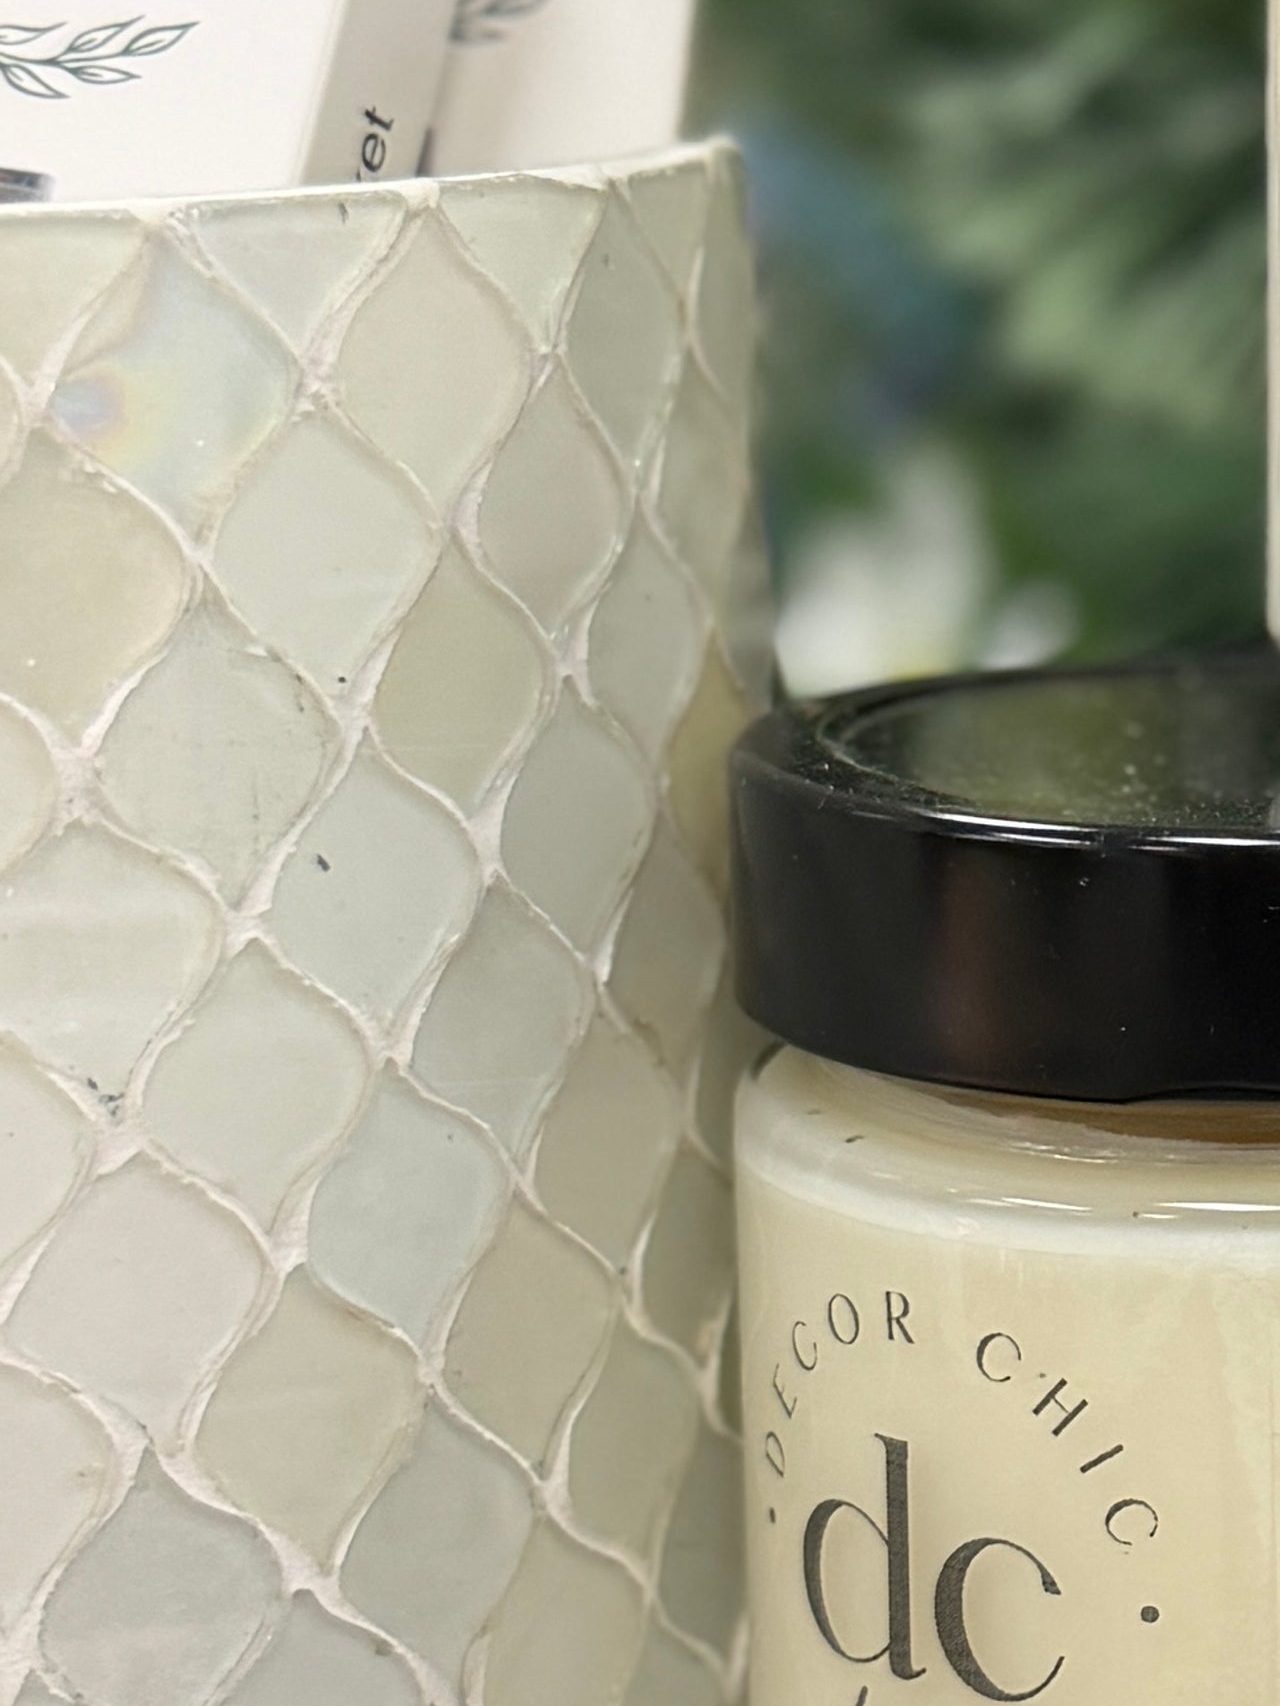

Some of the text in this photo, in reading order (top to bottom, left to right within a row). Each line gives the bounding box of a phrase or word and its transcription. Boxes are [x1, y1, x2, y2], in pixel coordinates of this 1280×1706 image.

[765, 1290, 1159, 1547] DECOR CHIC
[802, 1432, 1066, 1703] dc
